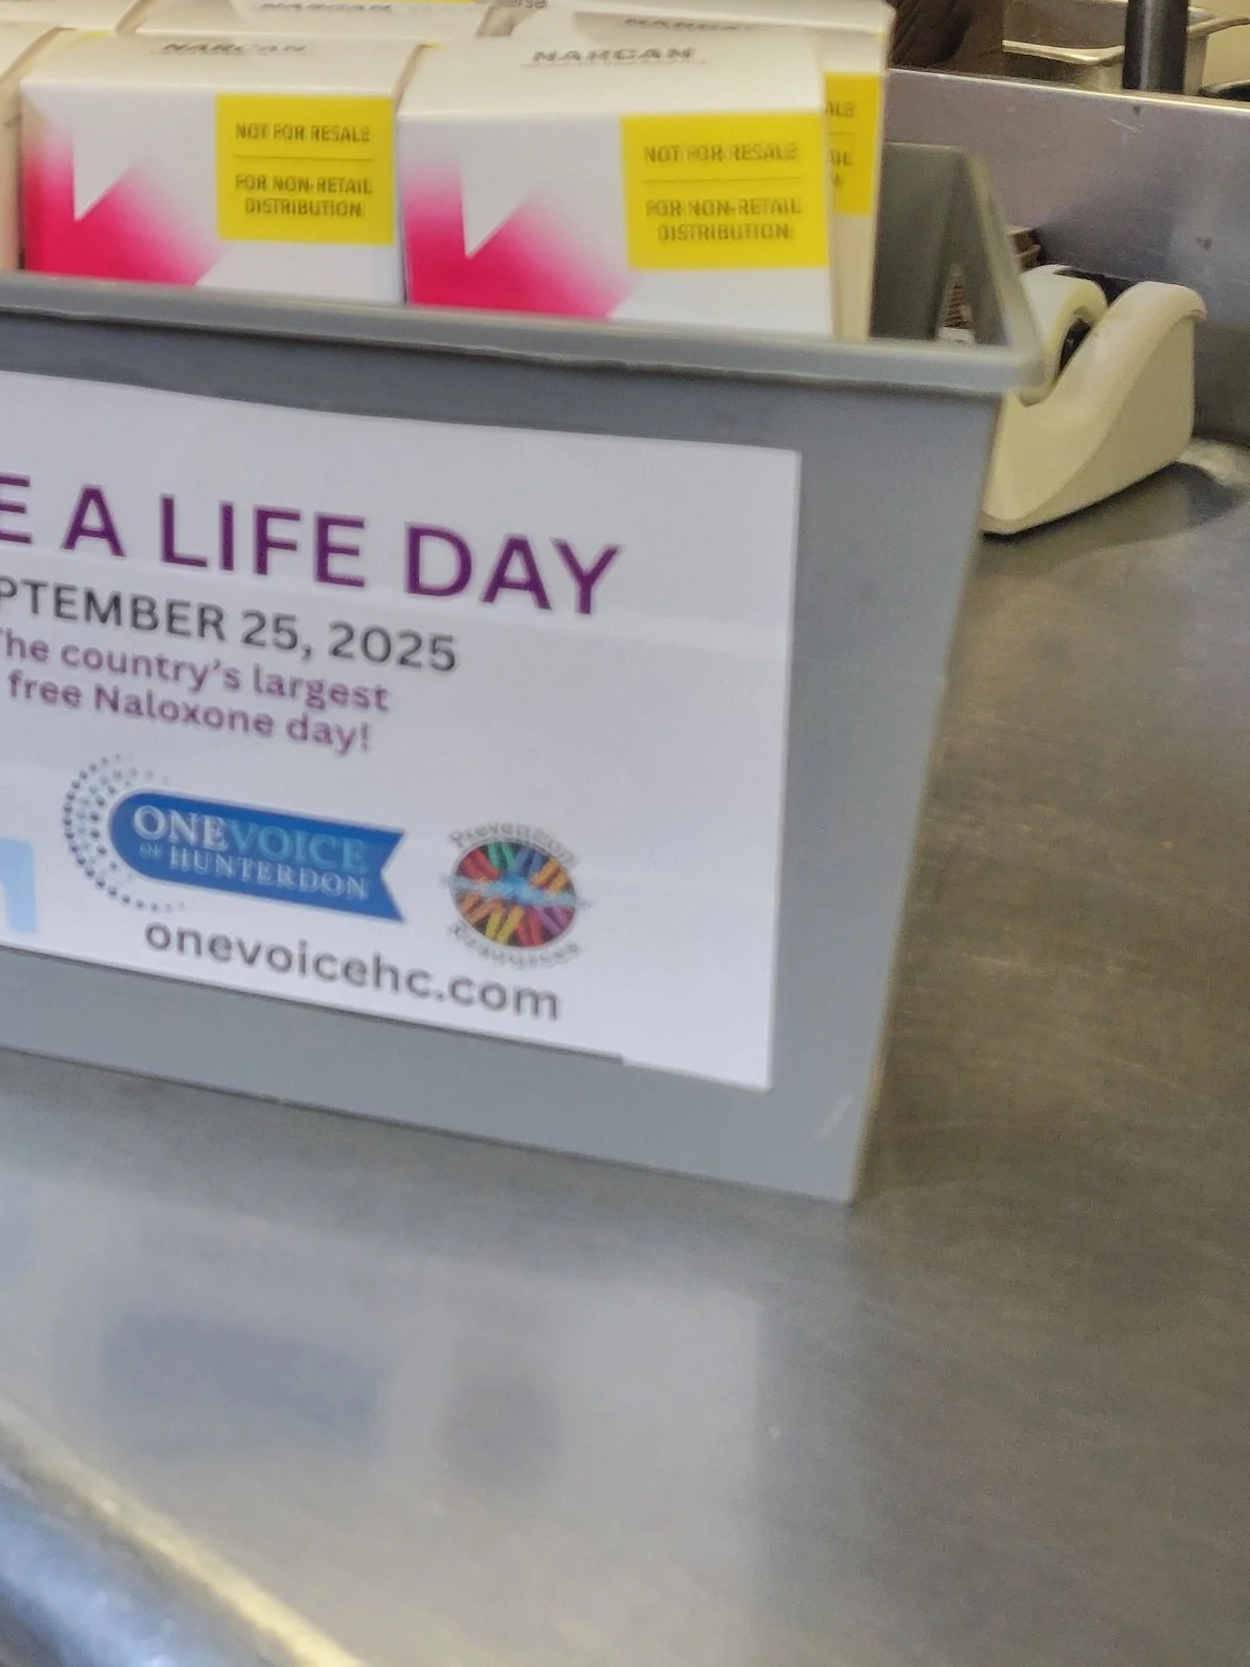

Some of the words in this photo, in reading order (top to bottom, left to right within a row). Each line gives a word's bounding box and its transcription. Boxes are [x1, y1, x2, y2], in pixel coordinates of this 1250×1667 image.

[161, 42, 309, 55] NARCAN
[532, 47, 697, 64] NARCAN
[235, 122, 270, 141] NOT
[273, 124, 305, 142] FOR
[309, 125, 371, 143] RESALE
[644, 145, 679, 164] NOT
[687, 144, 723, 163] FOR
[730, 143, 797, 162] RESALE
[235, 174, 268, 192] FOR
[272, 176, 373, 196] NON-RETAIL
[245, 198, 364, 218] DISTRIBUTION
[645, 199, 682, 217] FOR
[688, 198, 802, 216] NON-RETAIL
[657, 223, 790, 242] DISTRIBUTION
[61, 484, 127, 558] A
[161, 494, 365, 588] LIFE
[405, 522, 621, 615] DAY
[241, 609, 313, 662] 25,
[329, 621, 457, 672] 2025
[60, 642, 240, 694] country's
[253, 663, 389, 712] largest
[8, 668, 82, 707] free
[94, 682, 274, 737] Naloxone
[286, 713, 370, 755] day!
[169, 847, 369, 901] HUNTERDON
[144, 921, 561, 1021] onevoicehc.com
